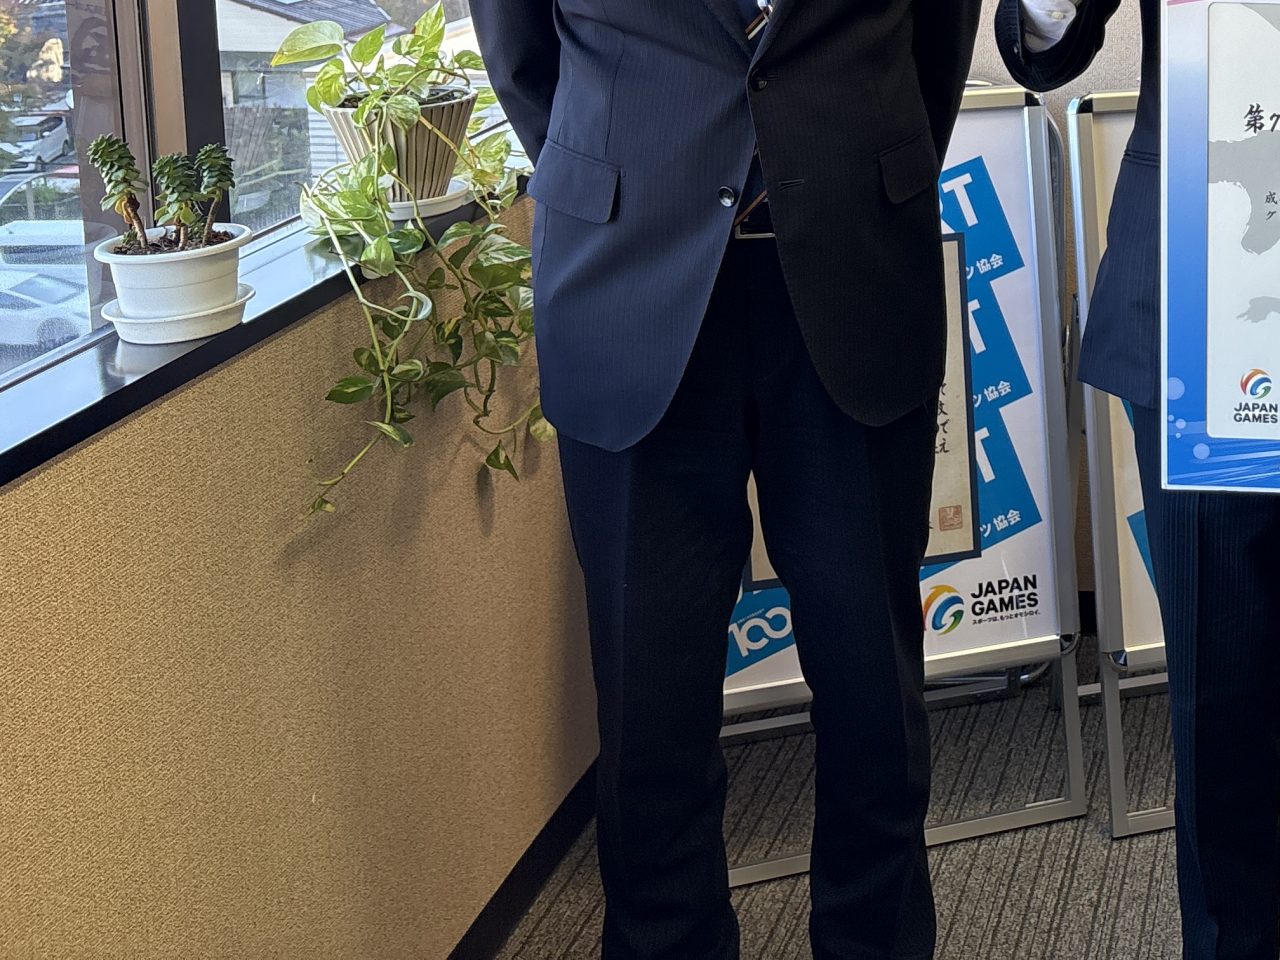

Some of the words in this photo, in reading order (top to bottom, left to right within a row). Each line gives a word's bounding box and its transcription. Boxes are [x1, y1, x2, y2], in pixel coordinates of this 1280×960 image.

[1234, 401, 1279, 414] JAPAN
[1233, 413, 1279, 424] GAMES
[970, 573, 1038, 600] JAPAN
[971, 591, 1040, 617] GAMES
